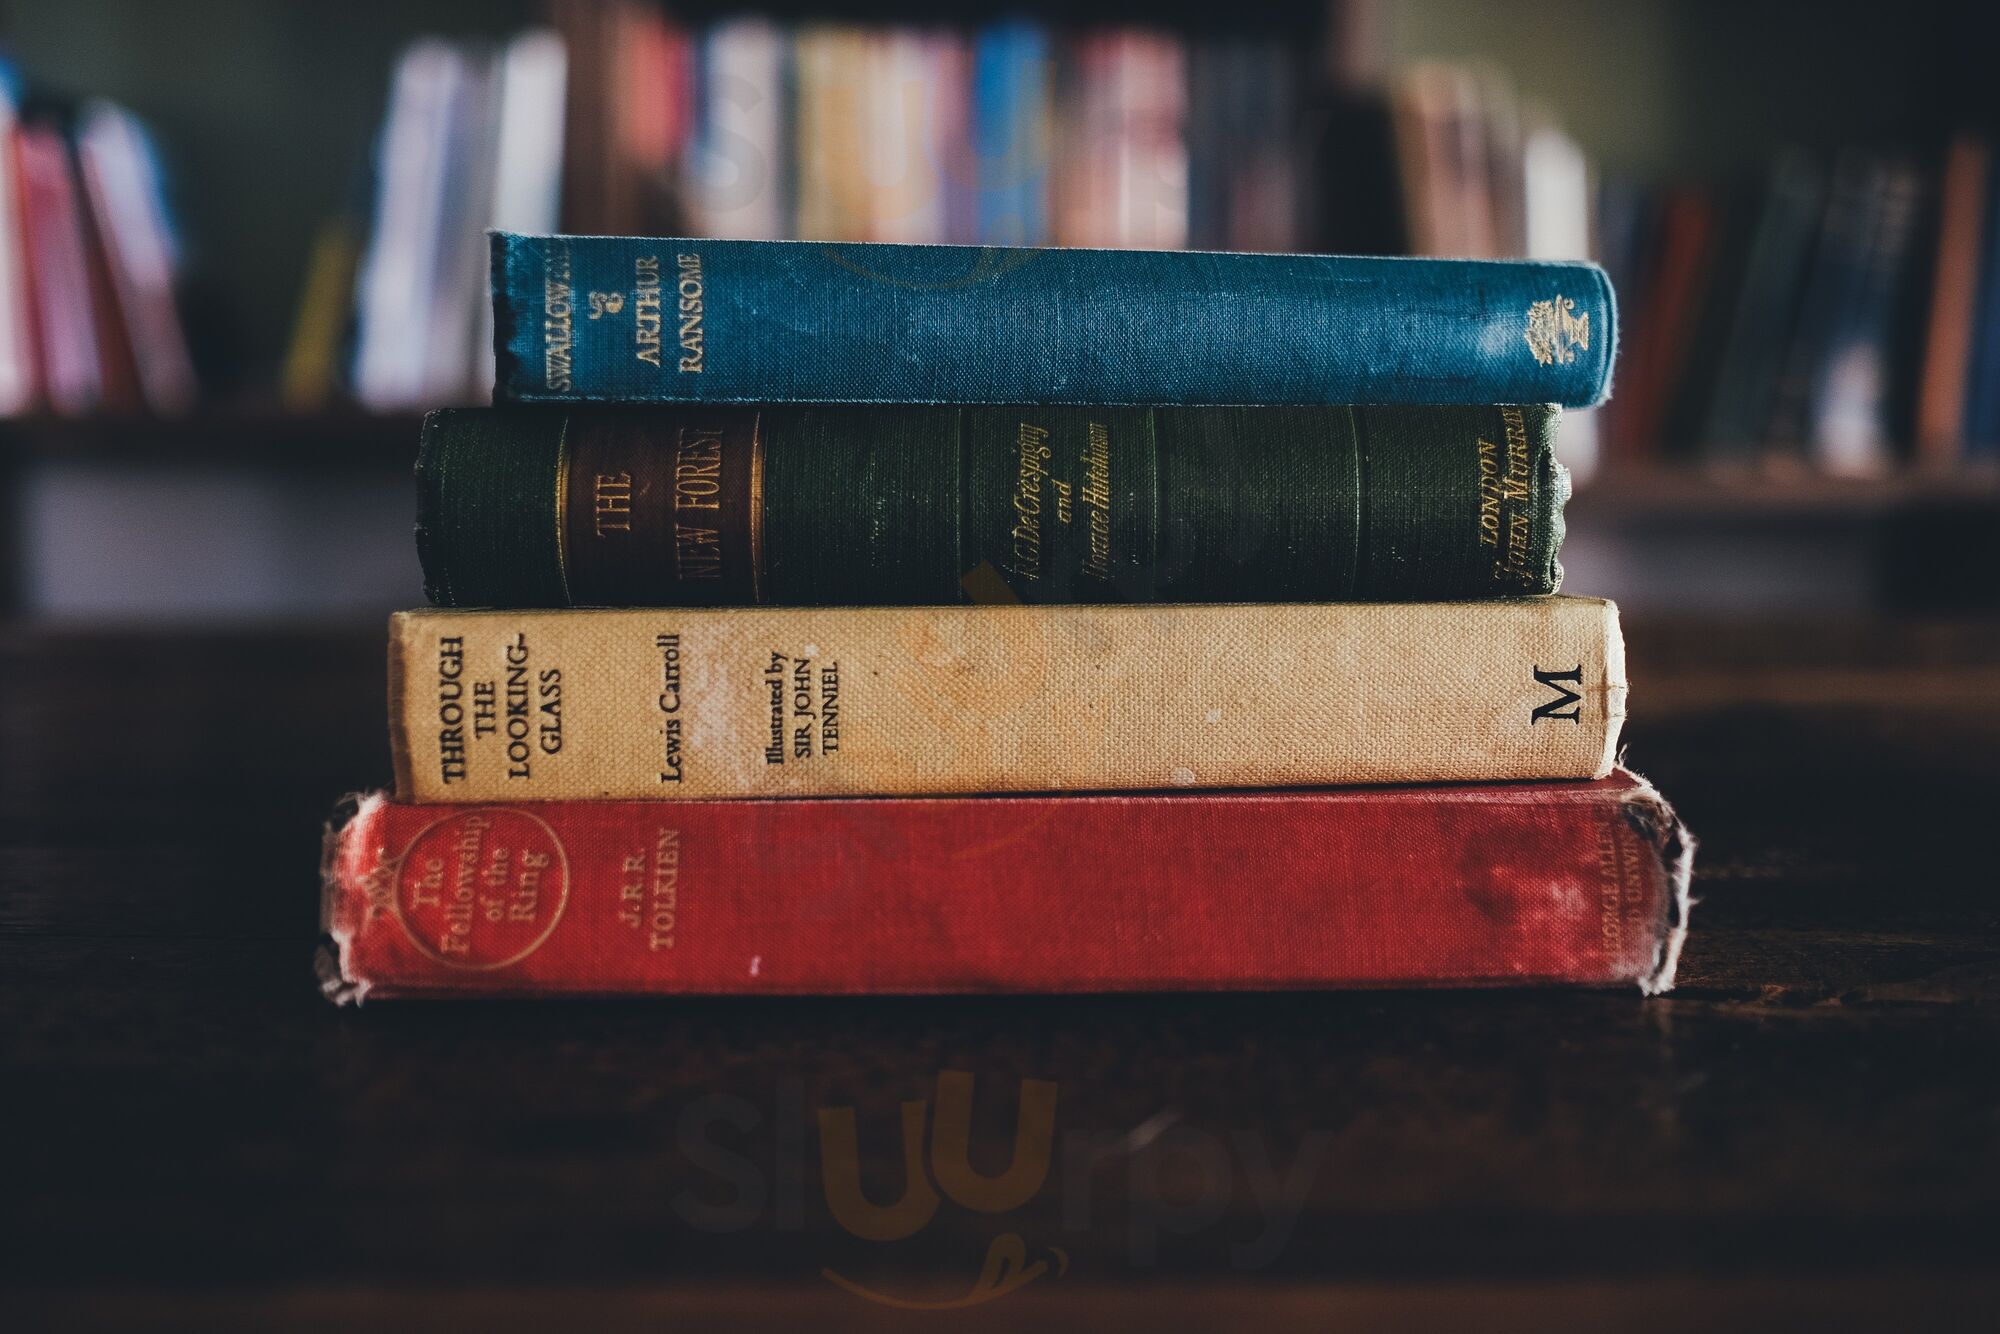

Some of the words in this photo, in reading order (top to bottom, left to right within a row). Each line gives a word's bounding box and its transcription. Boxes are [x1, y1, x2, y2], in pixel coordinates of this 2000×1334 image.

[636, 255, 661, 368] ARTHUR
[678, 253, 703, 374] RANSOME
[674, 426, 723, 511] FOREST
[1051, 478, 1073, 524] and
[1080, 422, 1110, 510] Hutchinson
[1477, 437, 1501, 548] LONDON
[594, 471, 631, 537] THE
[675, 522, 722, 581] NEW
[1081, 510, 1110, 581] Horace
[1494, 512, 1534, 587] JOHN
[657, 634, 682, 713] Carroll
[766, 652, 788, 673] by
[793, 658, 817, 720] JOHN
[1531, 664, 1582, 726] M
[439, 637, 466, 784] THROUGH
[473, 681, 497, 739] THE
[506, 633, 530, 779] LOOKING-
[539, 668, 562, 755] GLASS
[765, 679, 785, 765] Illustrated
[793, 722, 812, 758] SIR
[821, 661, 839, 755] TENNIEL
[660, 719, 682, 783] Lewis
[412, 858, 444, 908] The
[440, 817, 490, 953] Fellowship
[481, 848, 509, 888] the
[510, 849, 549, 923] Ring
[651, 827, 681, 951] TOLKIEN
[481, 898, 507, 922] of
